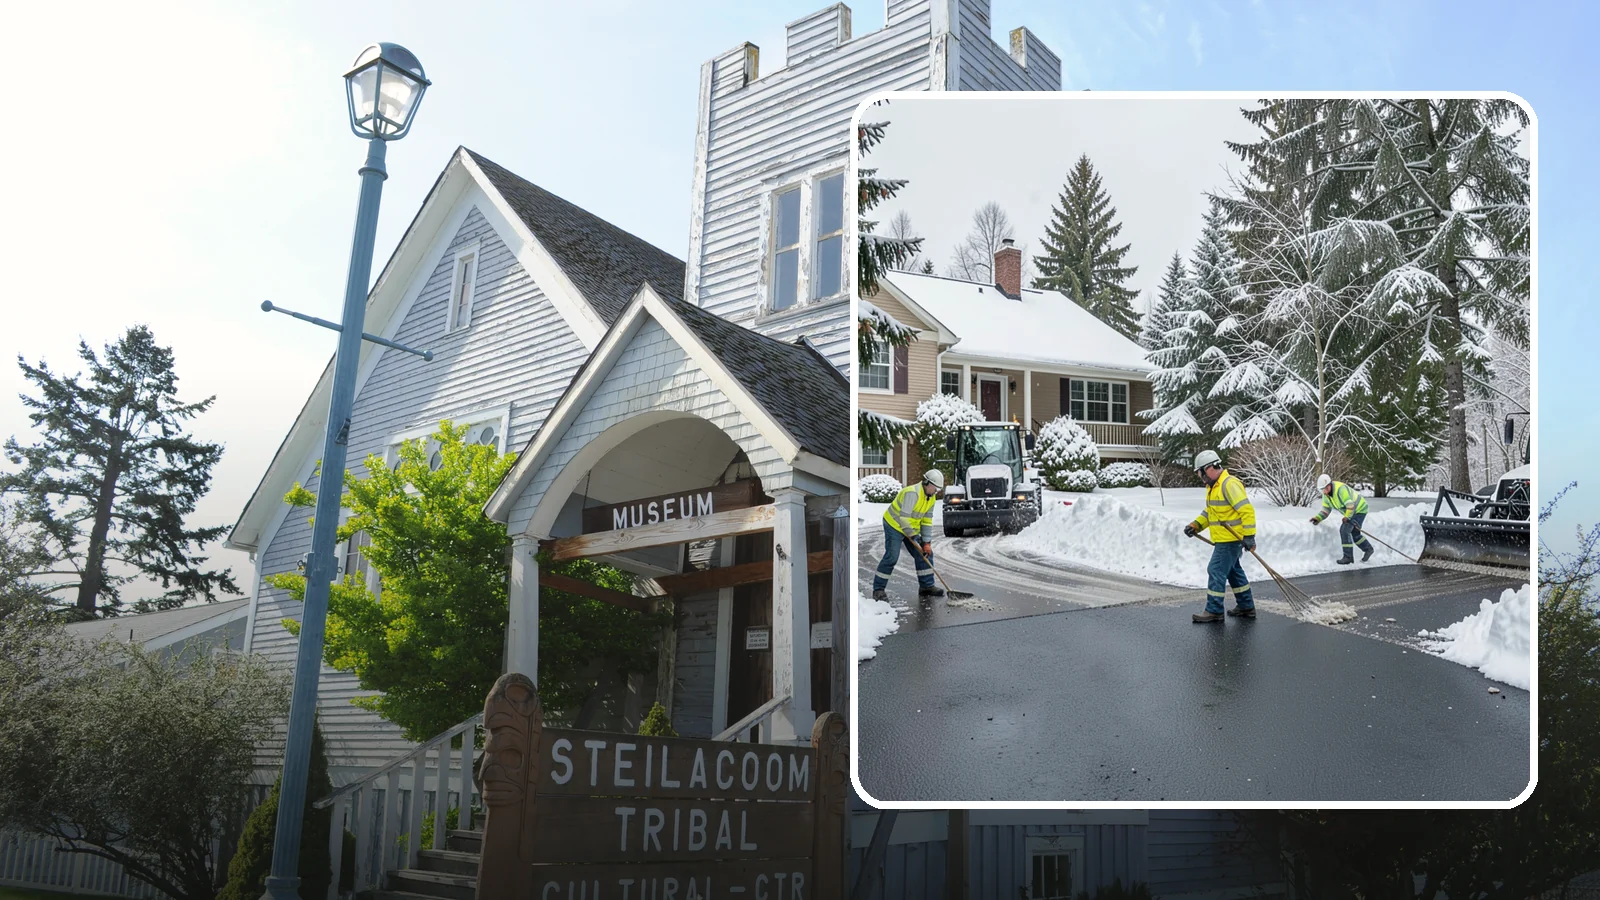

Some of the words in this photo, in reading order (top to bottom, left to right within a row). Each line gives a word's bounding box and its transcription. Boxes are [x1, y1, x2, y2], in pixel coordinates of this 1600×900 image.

[613, 491, 713, 530] MUSEUM
[551, 738, 809, 792] STEILACOOM
[615, 806, 758, 852] TRIBAL
